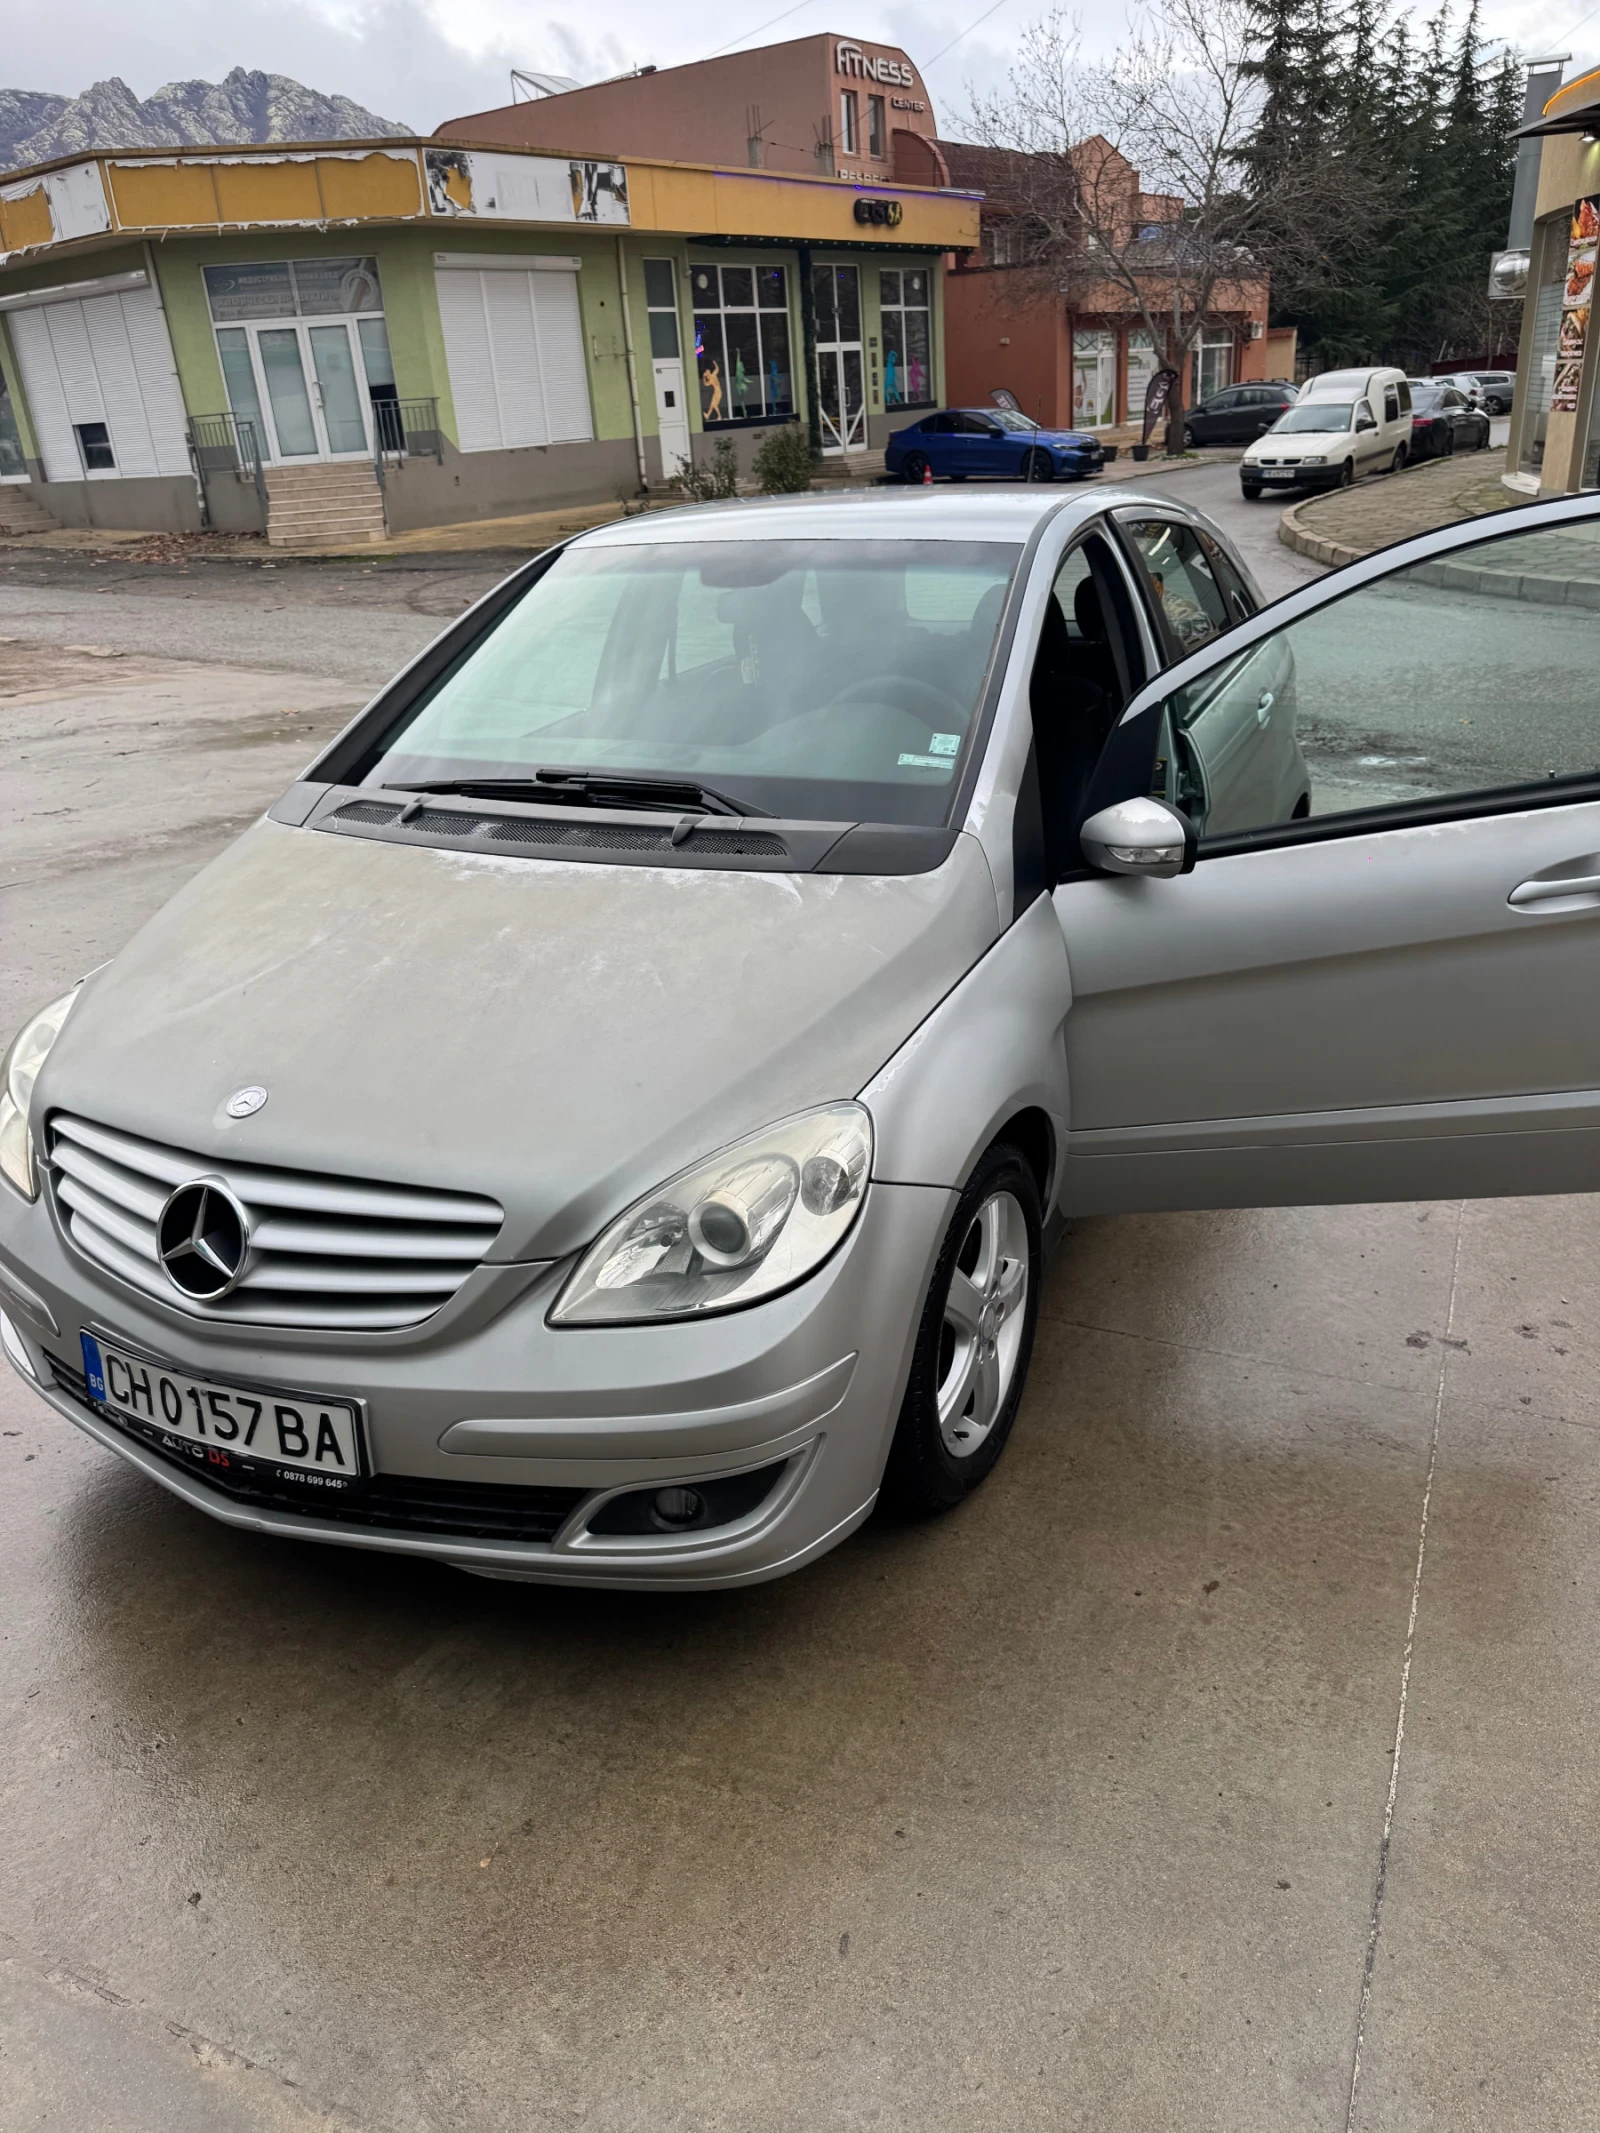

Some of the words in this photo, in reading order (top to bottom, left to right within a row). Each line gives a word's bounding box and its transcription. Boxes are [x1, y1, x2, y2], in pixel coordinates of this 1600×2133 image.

[836, 41, 914, 88] FITNESS
[892, 97, 926, 112] CENTER
[90, 1373, 104, 1391] BG
[208, 1449, 230, 1467] DS
[283, 1470, 305, 1482] 0878
[307, 1475, 324, 1486] 699
[325, 1478, 342, 1488] 645
